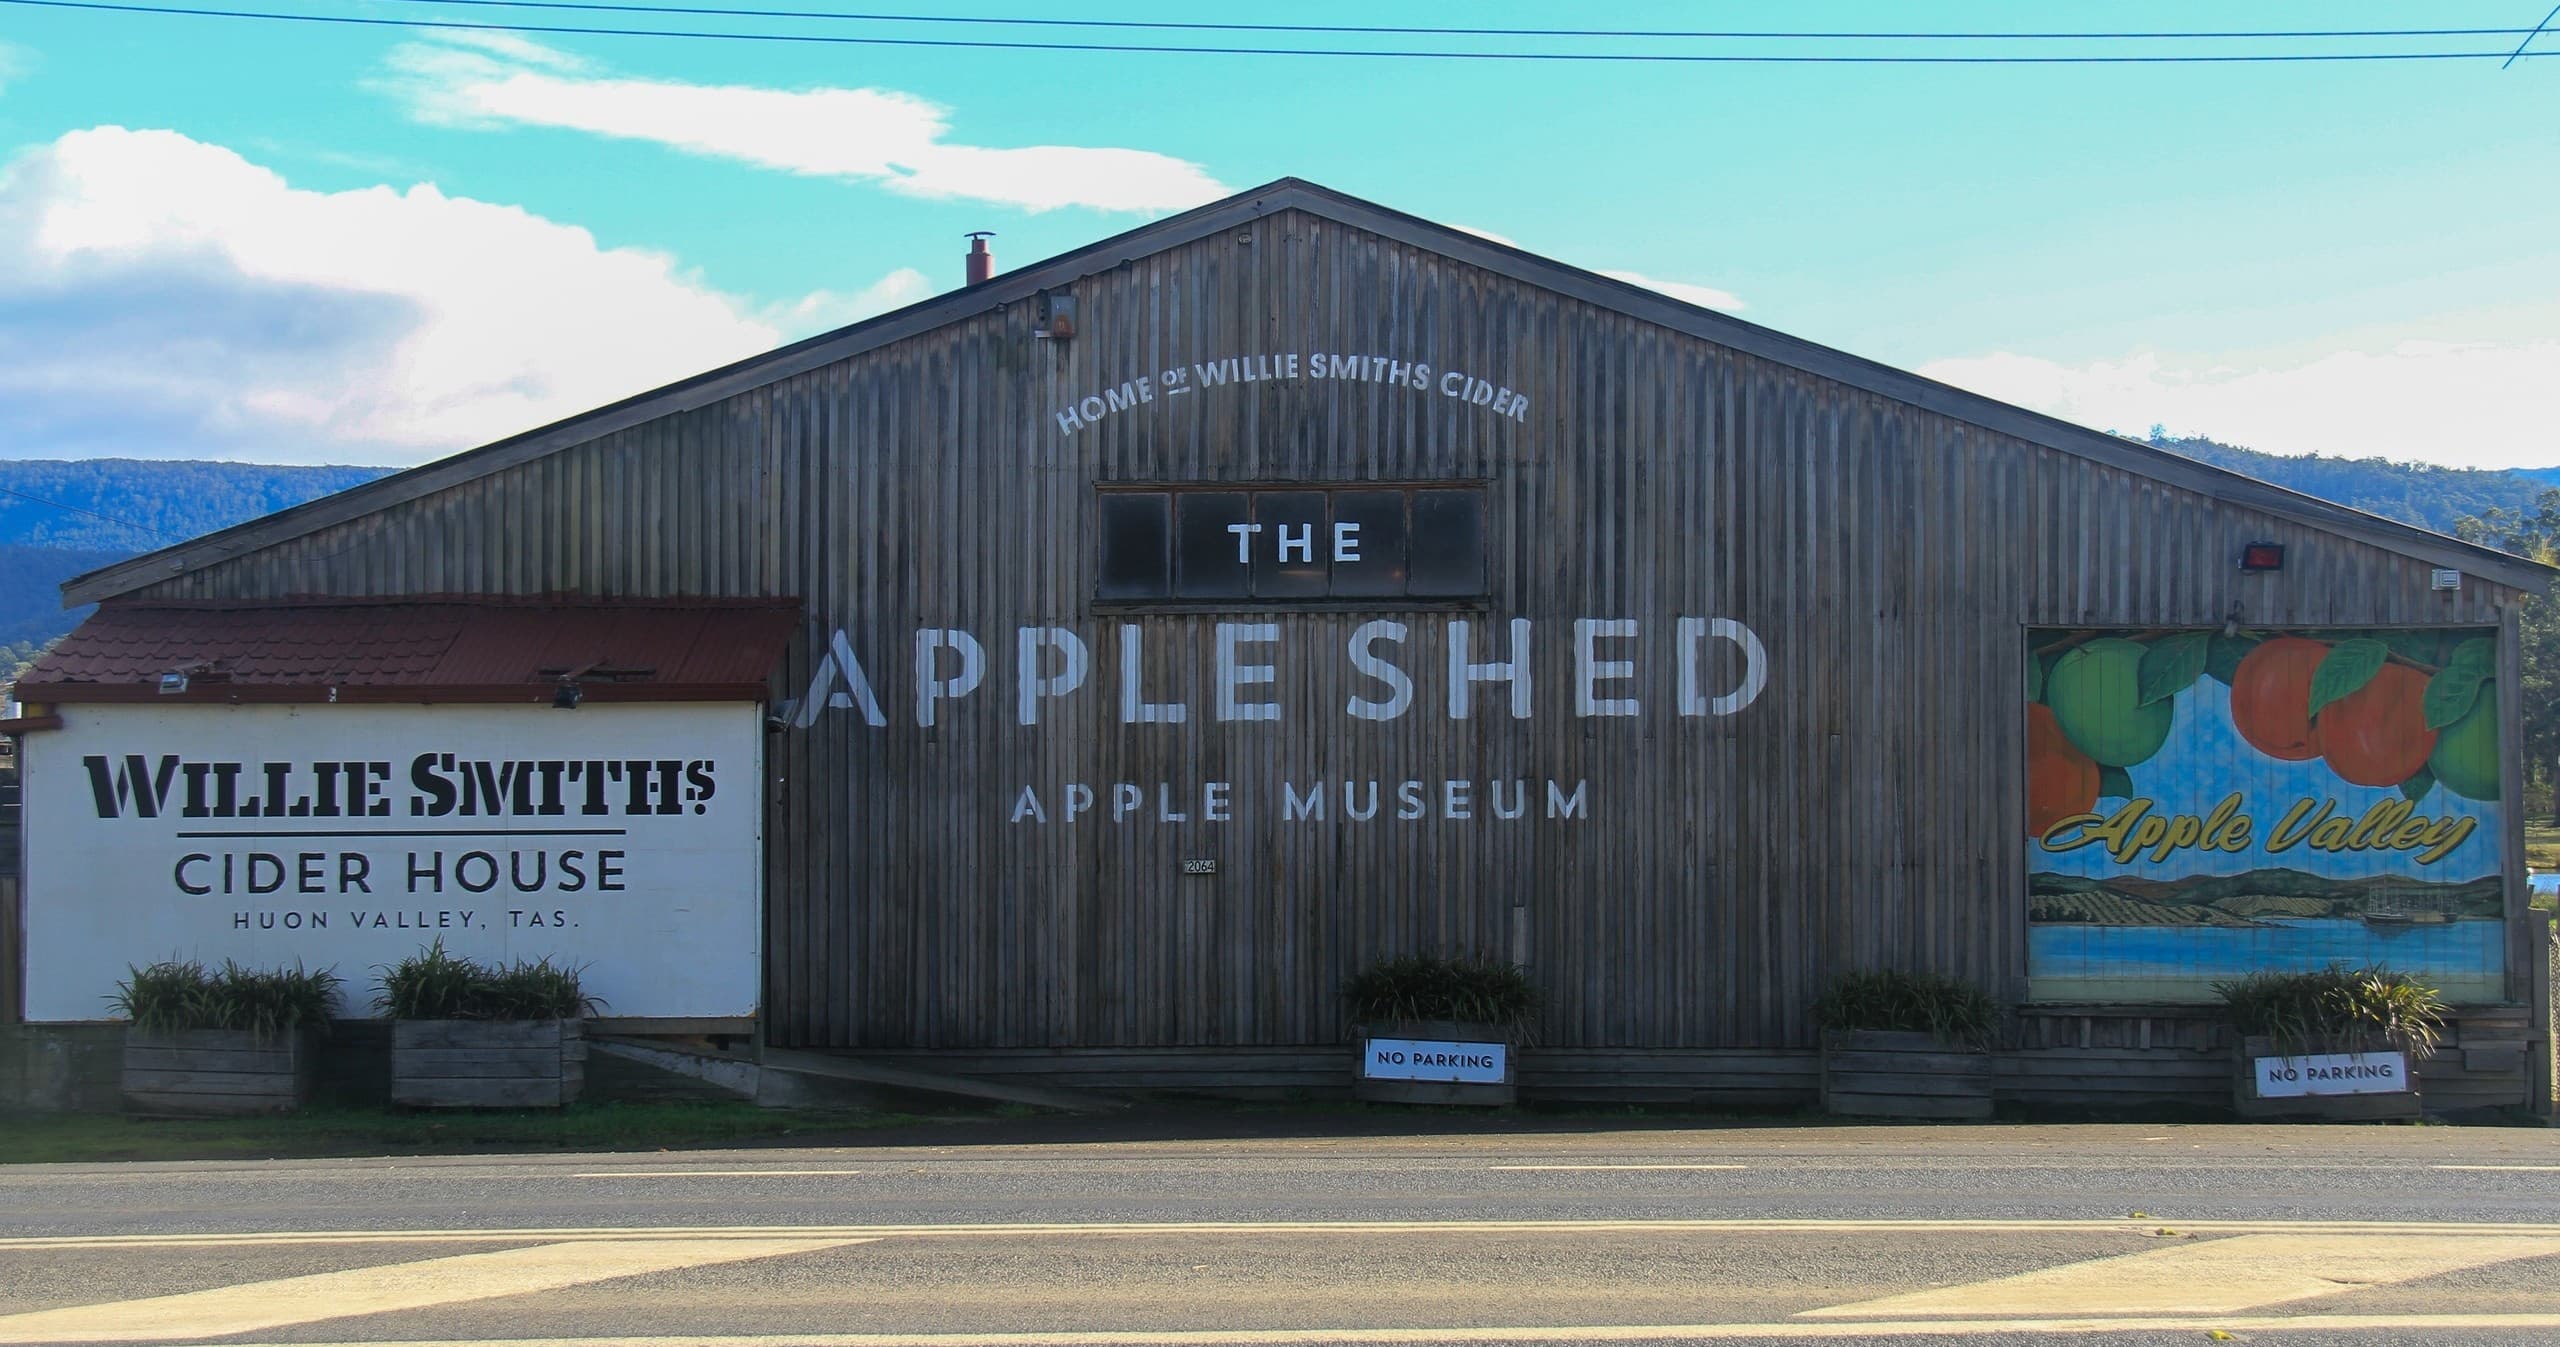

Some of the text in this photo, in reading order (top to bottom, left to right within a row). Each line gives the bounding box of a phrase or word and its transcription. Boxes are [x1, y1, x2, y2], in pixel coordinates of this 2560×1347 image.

[1056, 353, 1529, 437] HOME OF WILLIE SMITHS CIDER
[1227, 522, 1361, 564] THE
[795, 617, 1767, 728] APPLE SHED
[83, 755, 392, 818] WILLIE
[1011, 778, 1589, 823] APPLE MUSEUM
[2039, 792, 2478, 865] Apple Valley
[174, 850, 626, 894] CIDER HOUSE
[1188, 861, 1215, 872] 2064
[234, 910, 580, 931] HUON VALLEY, TAS.
[1378, 1051, 1494, 1069] NO PARKING
[2269, 1064, 2393, 1083] NO PARKING
